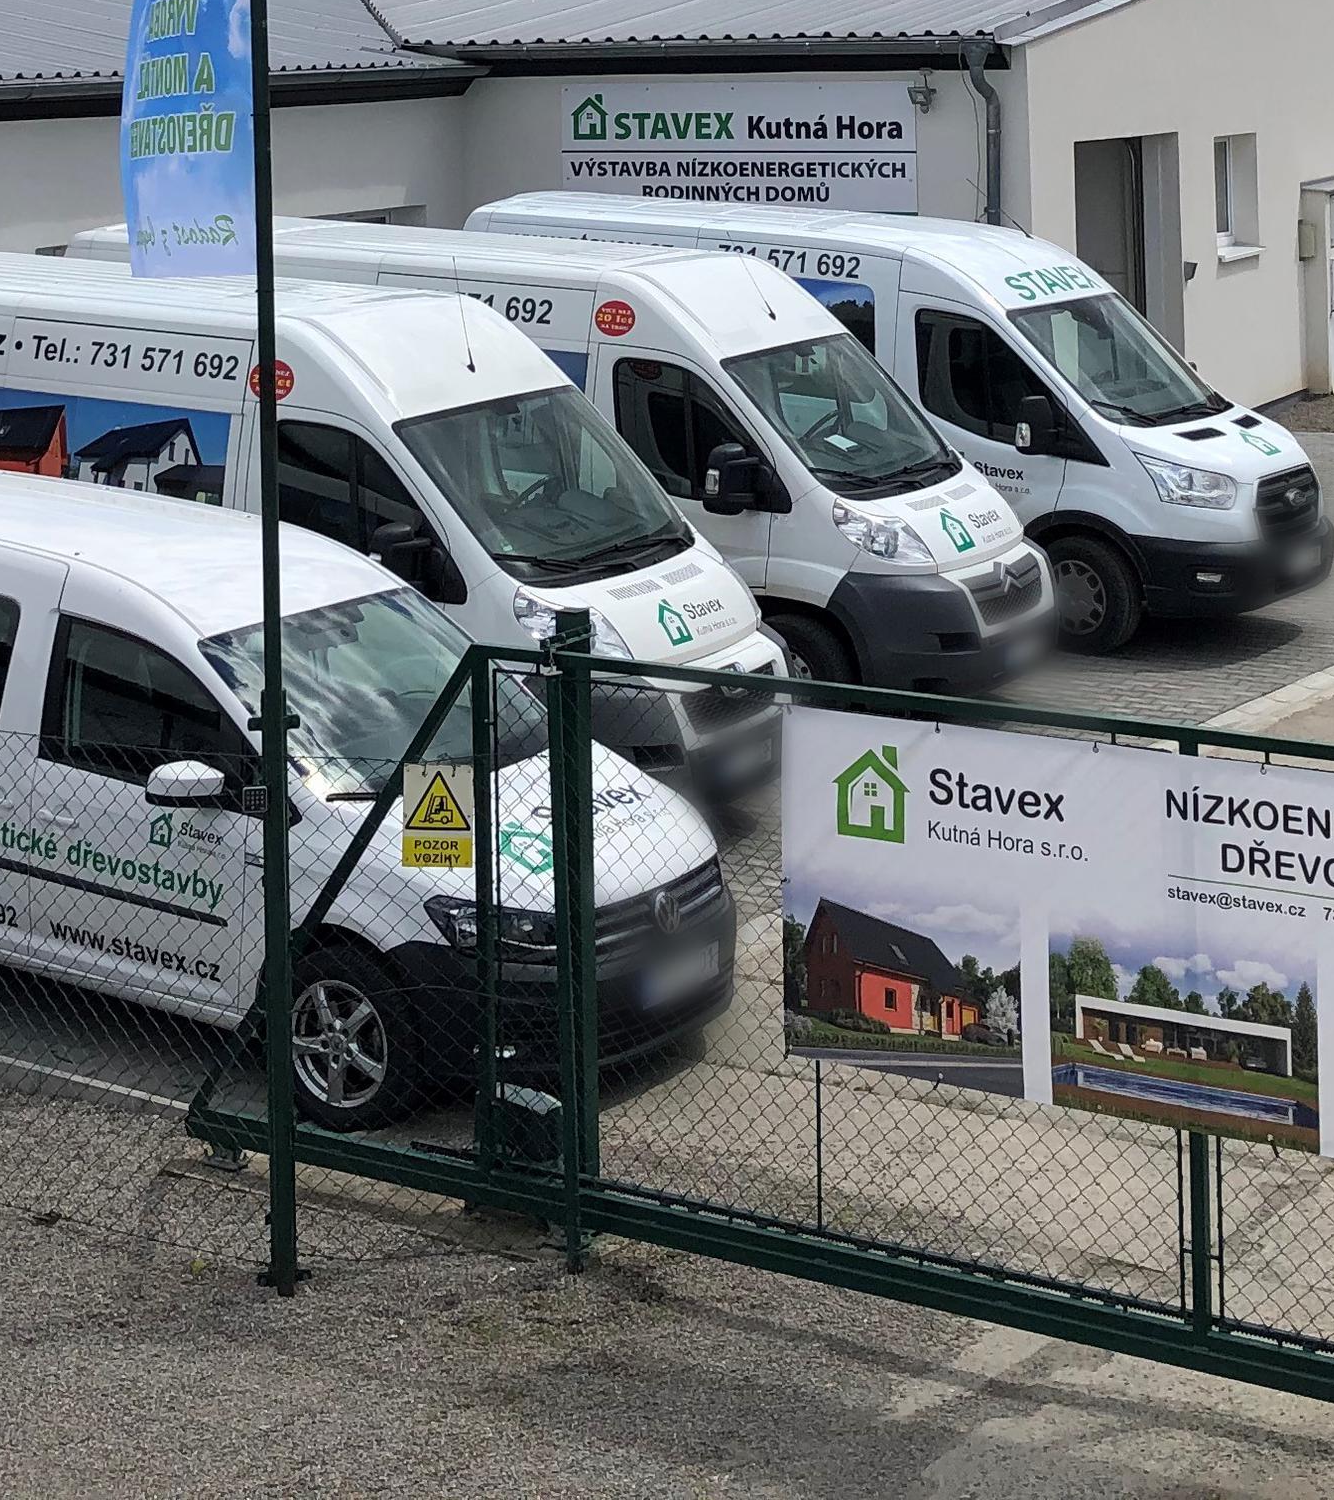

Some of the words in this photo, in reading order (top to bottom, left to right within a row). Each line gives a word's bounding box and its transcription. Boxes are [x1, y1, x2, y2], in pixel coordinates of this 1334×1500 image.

[614, 112, 734, 140] STAVEX
[747, 114, 828, 140] Kutná
[836, 115, 903, 140] Hora
[571, 157, 671, 177] VÝSTAVBA
[677, 157, 907, 179] NÍZKOENERGETICKÝCH
[642, 181, 760, 202] RODINNÝCH
[766, 181, 830, 202] DOMŮ
[768, 249, 807, 274] 571
[817, 253, 861, 279] 692
[1004, 265, 1103, 301] STAVEX
[505, 296, 553, 325] 692
[31, 335, 81, 365] Tel.:
[90, 341, 132, 369] 731
[140, 347, 185, 375] 571
[193, 353, 240, 381] 692
[973, 461, 1024, 480] Stavex
[683, 598, 725, 620] Stavex
[929, 768, 1064, 822] Stavex
[180, 822, 224, 845] Stavex
[414, 840, 459, 850] POZOR
[928, 820, 980, 846] Kutná
[988, 829, 1034, 854] Hora
[1040, 841, 1088, 862] s.r.o.
[414, 852, 461, 863] VOZÍKY
[66, 840, 224, 910] dřevostavby
[1167, 886, 1306, 918] stavex@stavex.cz
[50, 920, 221, 982] www.stavex.cz
